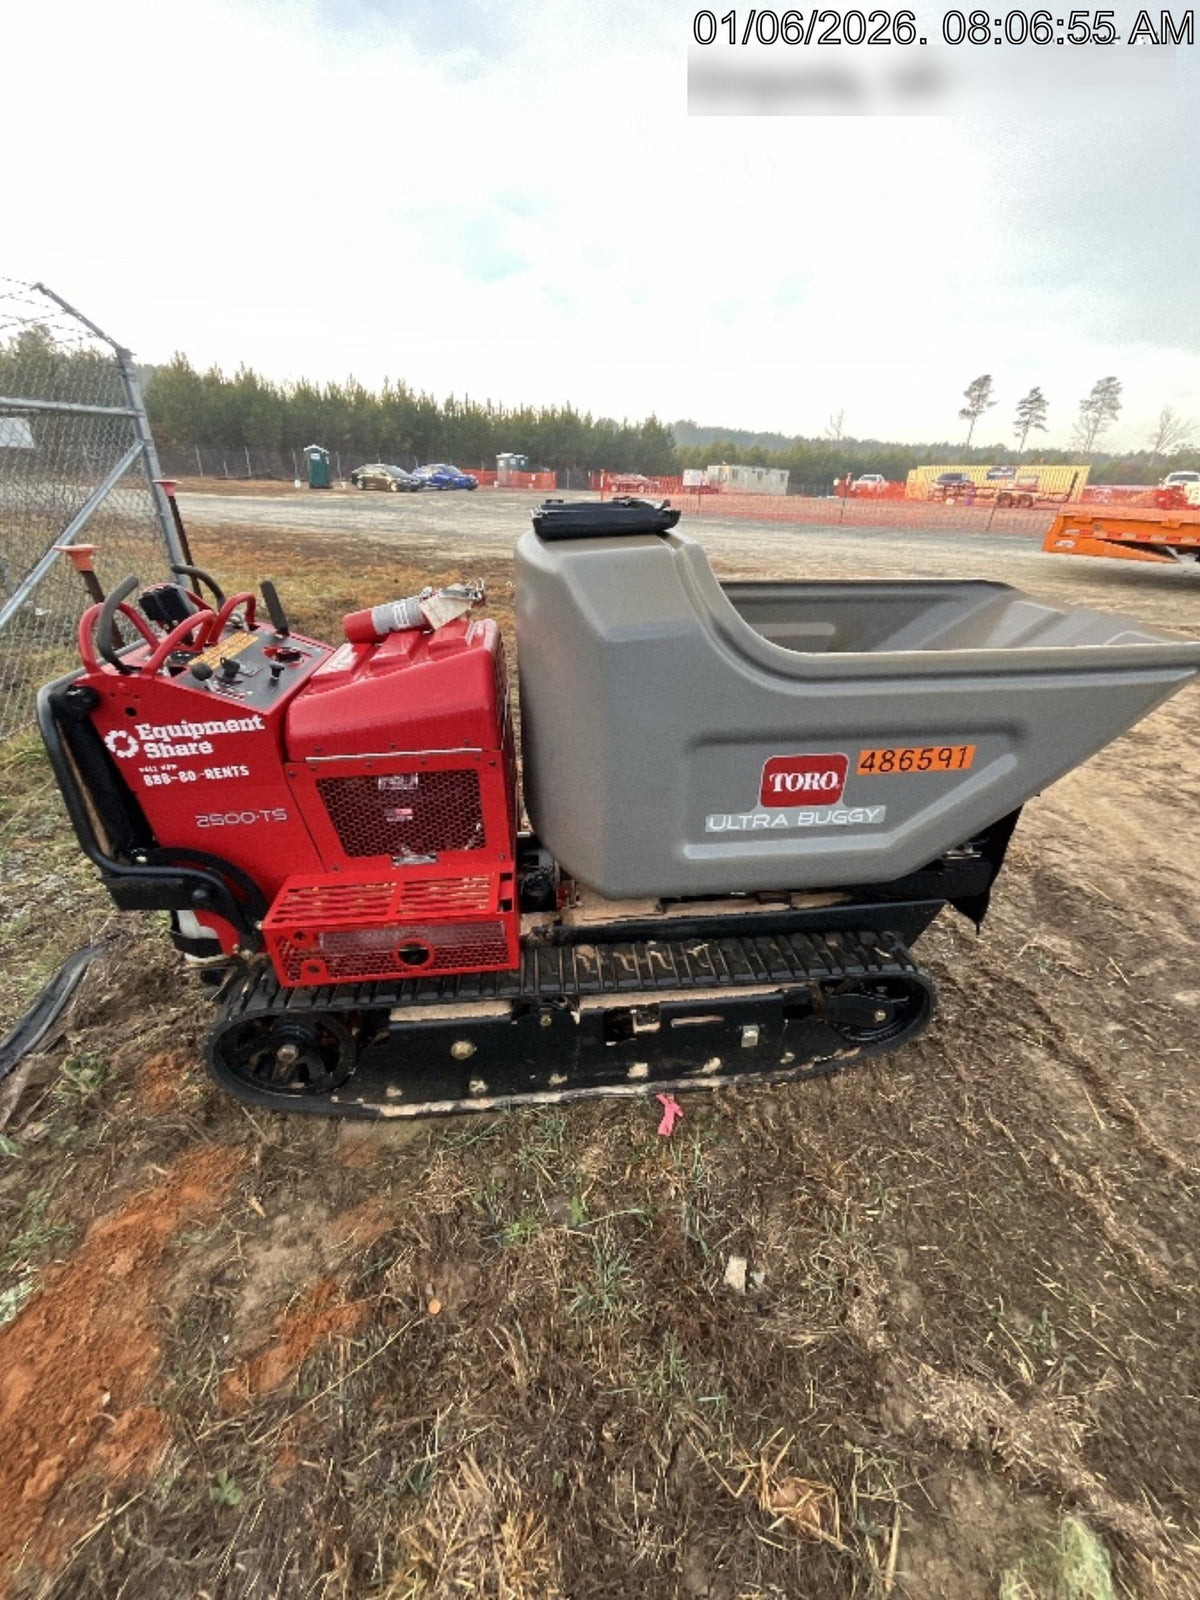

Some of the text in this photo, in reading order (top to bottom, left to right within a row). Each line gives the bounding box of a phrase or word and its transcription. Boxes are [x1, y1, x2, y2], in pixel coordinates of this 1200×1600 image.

[135, 715, 265, 741] Equipment
[143, 740, 214, 759] Share
[860, 747, 968, 772] 486591
[769, 770, 838, 793] TORO
[708, 807, 881, 831] ULTRA BUGGY
